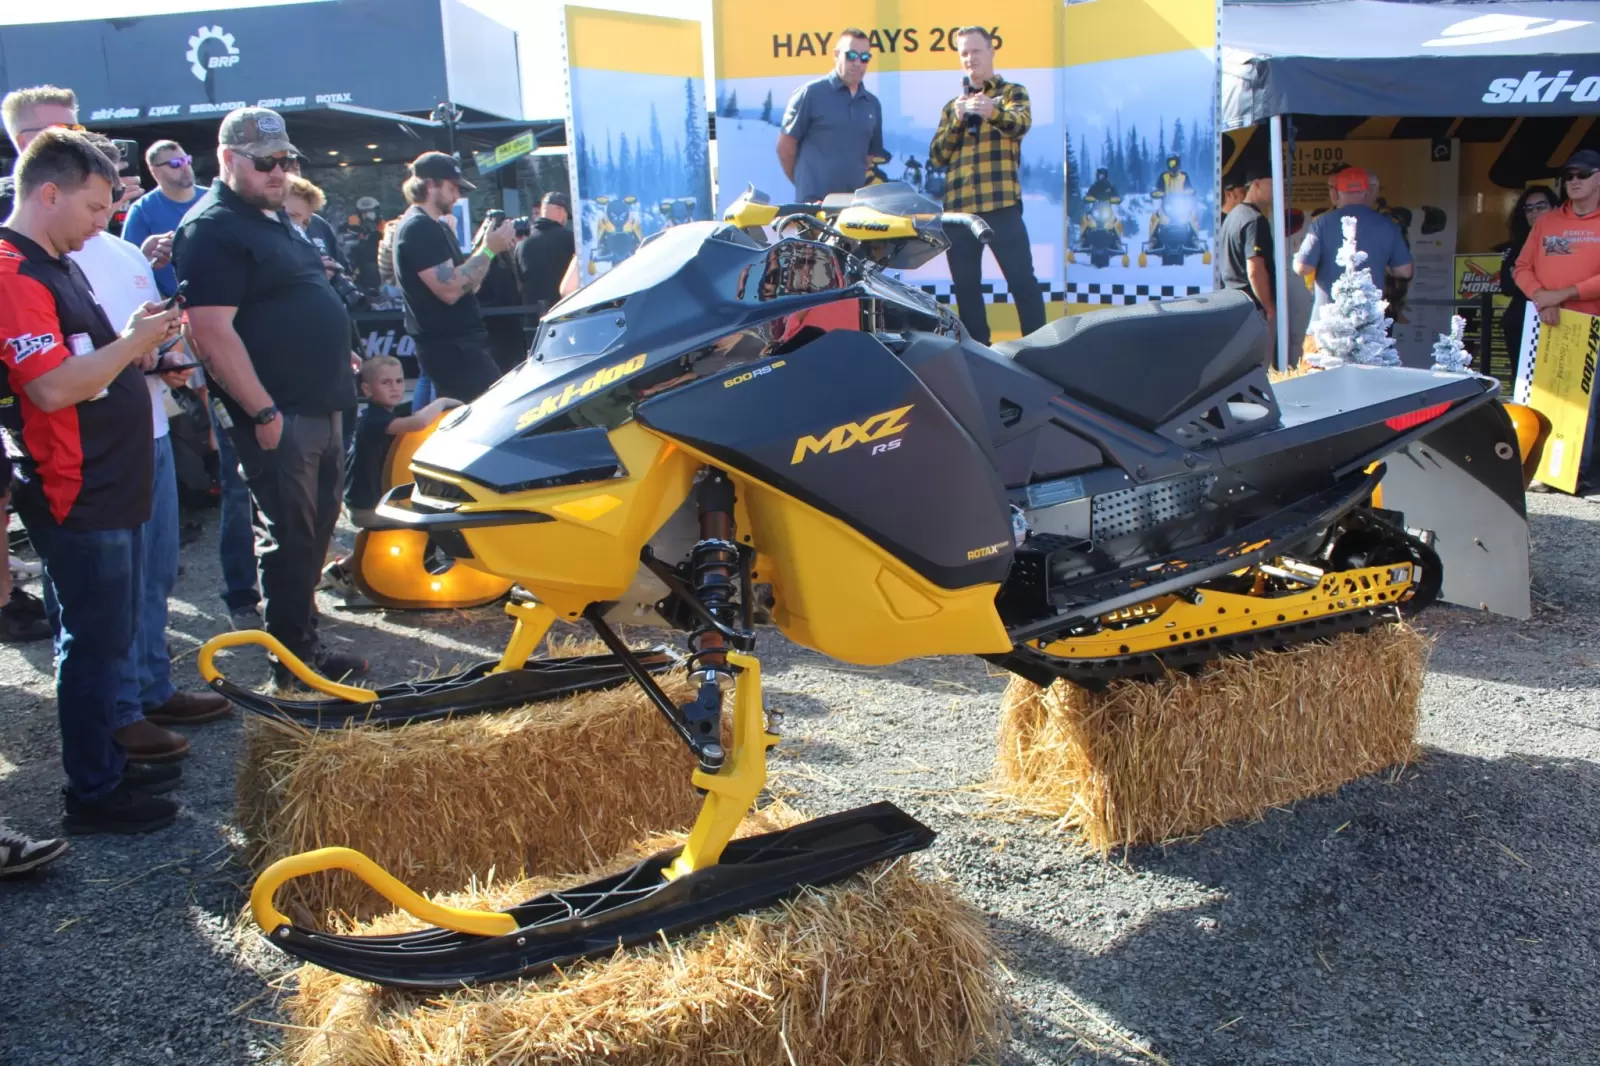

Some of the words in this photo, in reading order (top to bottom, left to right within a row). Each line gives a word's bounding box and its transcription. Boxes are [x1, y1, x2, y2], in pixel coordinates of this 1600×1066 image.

[773, 32, 833, 57] HAY
[868, 27, 919, 53] AYS
[929, 26, 1003, 52] 206
[208, 55, 240, 68] BRP
[91, 107, 140, 120] ski-doo
[147, 104, 181, 117] LYNX
[315, 93, 352, 104] ROTAX
[1460, 282, 1503, 293] MORG
[515, 353, 647, 431] ski-doo
[790, 404, 915, 465] MXZ
[871, 438, 903, 456] RS
[967, 544, 998, 560] ROTAX
